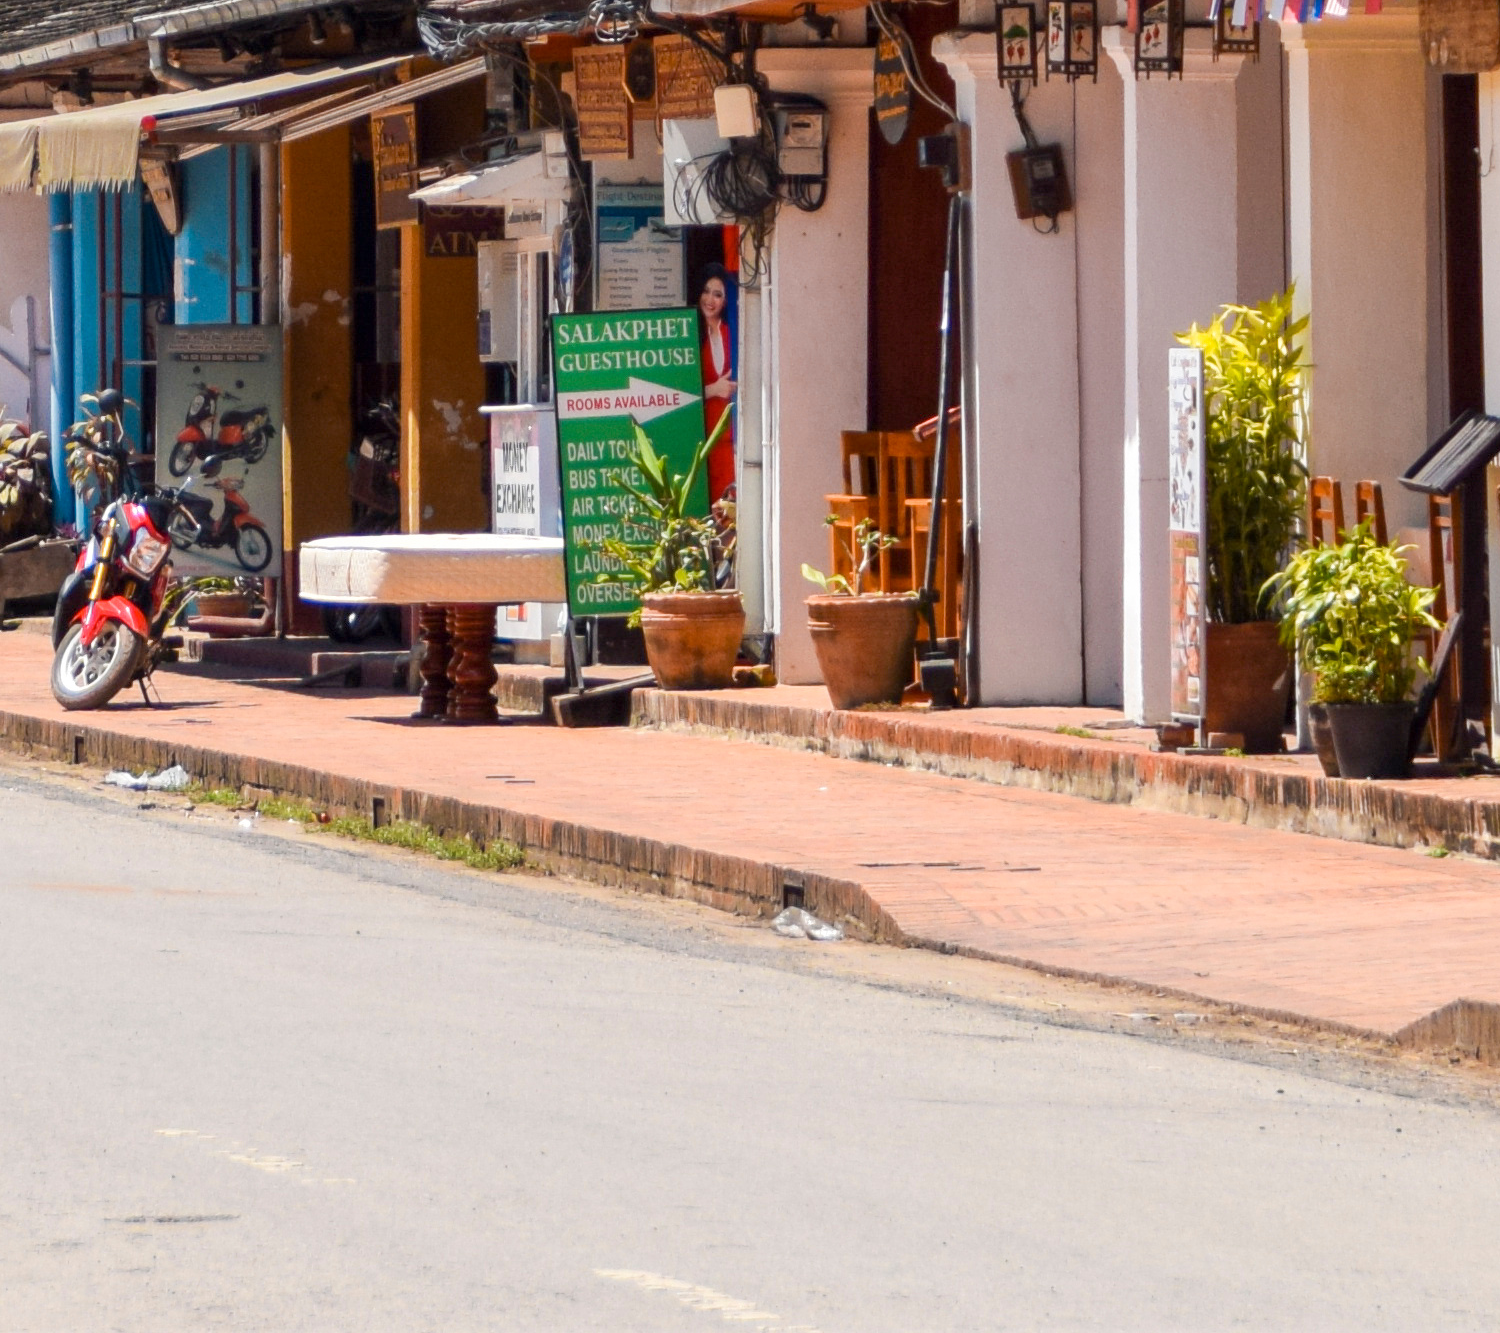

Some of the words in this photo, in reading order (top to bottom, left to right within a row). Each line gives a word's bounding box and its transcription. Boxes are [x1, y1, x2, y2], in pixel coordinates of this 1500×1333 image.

[428, 231, 488, 255] ATM
[558, 317, 692, 345] SALAKPHET
[559, 347, 696, 372] GUESTHOUSE
[566, 397, 611, 412] ROOMS
[614, 393, 680, 409] AVAILABLE
[502, 441, 529, 473] MONEY
[567, 440, 606, 462] DAILY
[569, 469, 597, 489] BUS
[496, 483, 536, 514] EXCHANGE
[572, 496, 594, 517] AIR
[573, 524, 620, 546] MONEY
